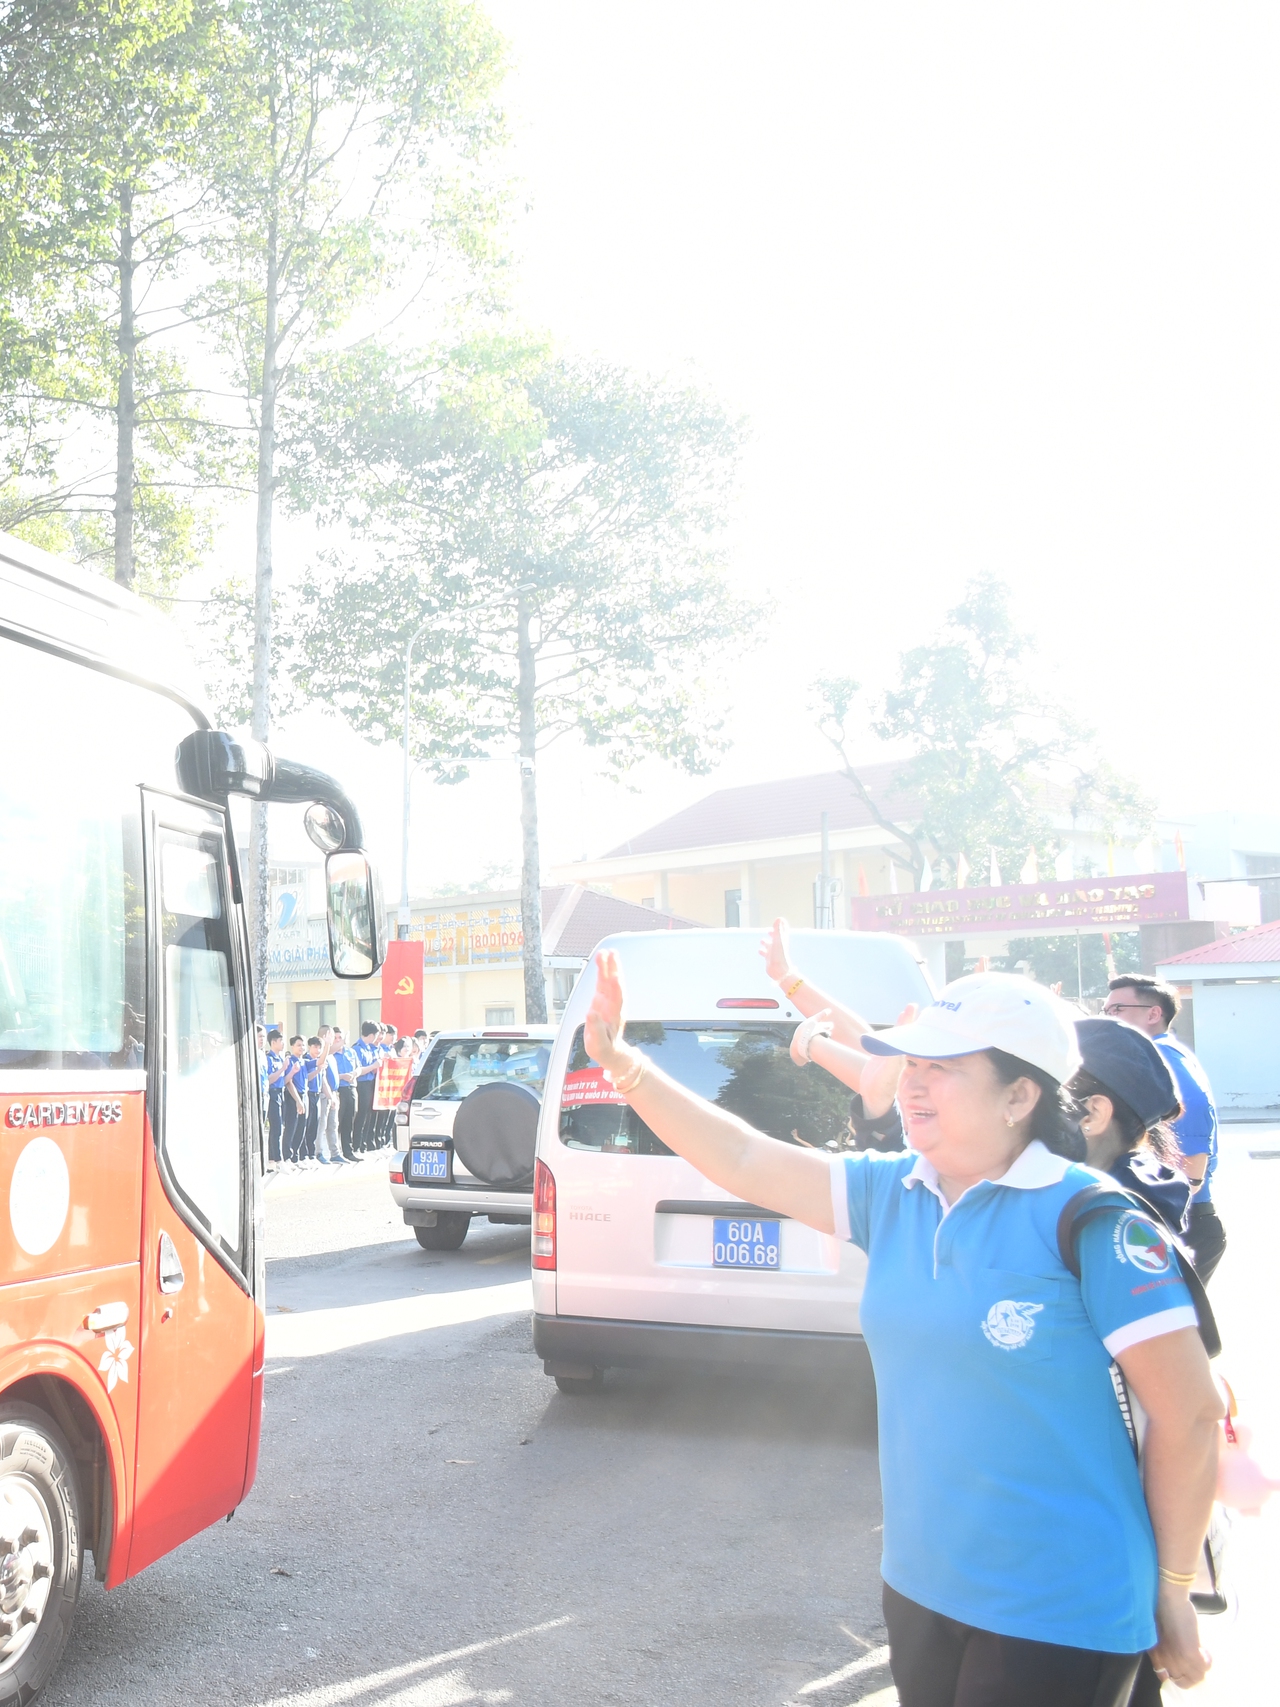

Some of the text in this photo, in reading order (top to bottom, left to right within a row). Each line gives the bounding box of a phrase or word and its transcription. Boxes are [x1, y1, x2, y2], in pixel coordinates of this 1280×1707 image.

[420, 1151, 438, 1163] 93A
[413, 1163, 445, 1176] 001.07
[569, 1212, 611, 1222] HIACE
[728, 1221, 764, 1243] 60A
[714, 1242, 778, 1267] 006.68
